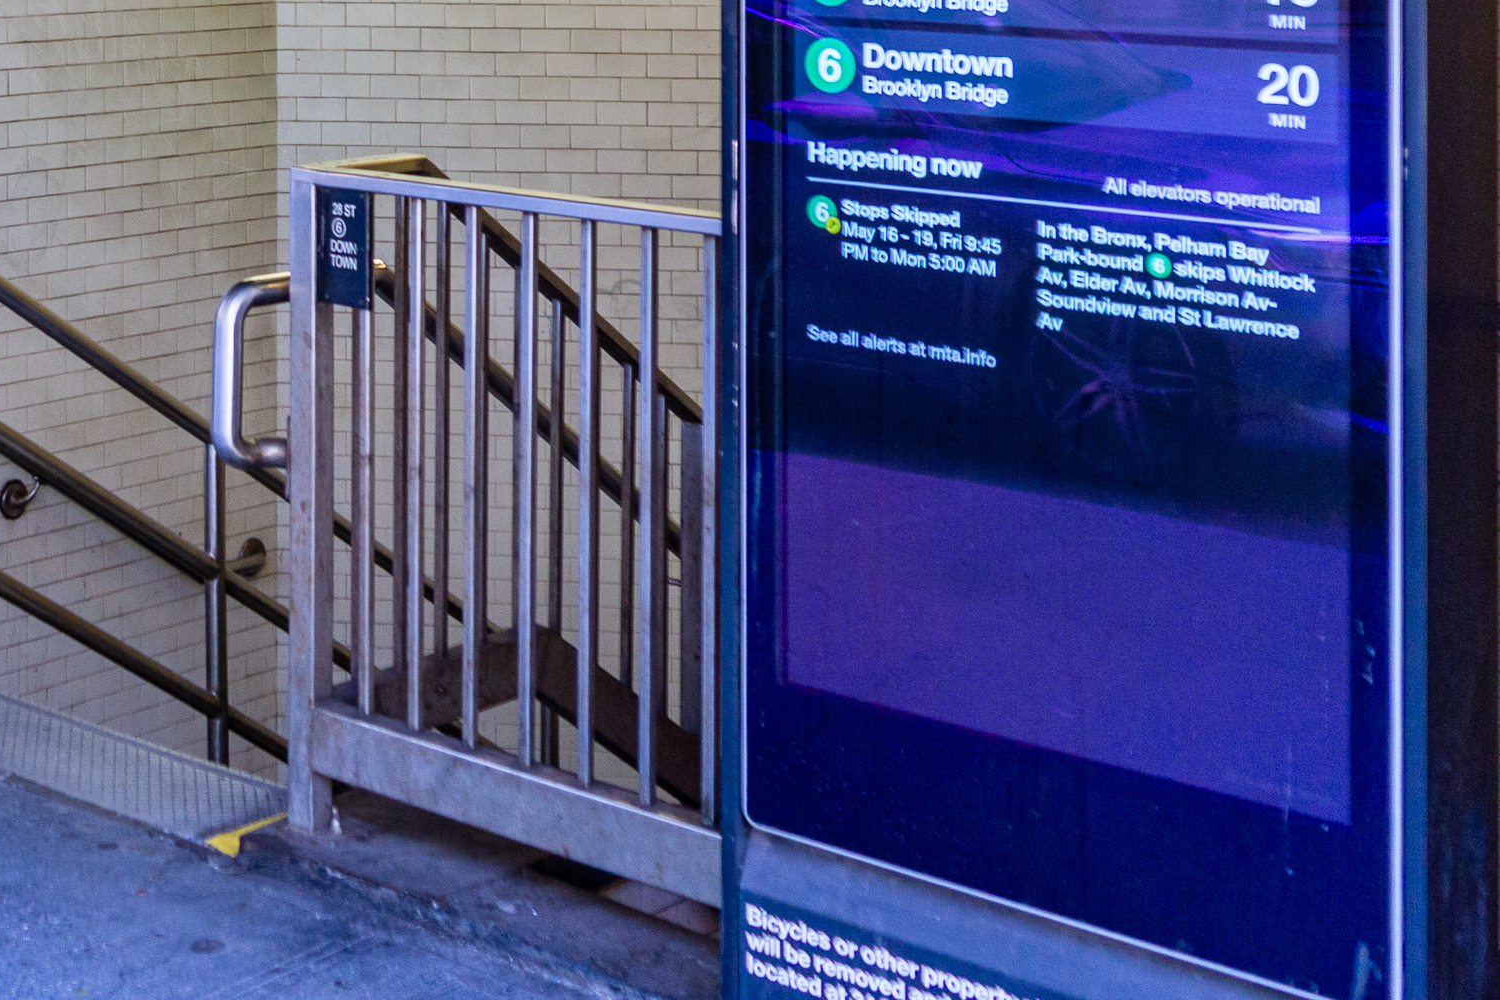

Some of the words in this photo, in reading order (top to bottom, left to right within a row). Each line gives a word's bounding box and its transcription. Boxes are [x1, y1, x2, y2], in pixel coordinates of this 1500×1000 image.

[1268, 14, 1306, 30] MIN
[817, 47, 841, 83] 6
[863, 42, 1014, 78] Downtown
[862, 75, 942, 103] Brooklyn
[945, 80, 1009, 108] Bridge
[1257, 62, 1320, 107] 20
[1268, 112, 1306, 129] MIN
[807, 141, 927, 178] Happening
[930, 157, 983, 179] now
[332, 202, 343, 216] 28
[344, 204, 357, 218] ST
[814, 202, 830, 223] 6
[1103, 176, 1127, 195] All
[1129, 179, 1212, 203] elevators
[1213, 191, 1320, 214] operational
[840, 198, 889, 221] Stops
[891, 204, 961, 229] Skipped
[841, 220, 876, 243] May
[878, 225, 899, 243] 16
[912, 229, 937, 250] 19,
[939, 231, 962, 251] Fri
[964, 235, 1002, 255] 9:45
[1037, 219, 1056, 239] In
[1058, 223, 1089, 243] the
[1090, 225, 1152, 252] Bronx,
[1154, 232, 1226, 258] Pelham
[1228, 240, 1270, 266] Bay
[330, 254, 357, 271] TOWN
[841, 241, 868, 261] PM
[871, 246, 888, 264] to
[890, 248, 926, 269] Mon
[928, 253, 965, 274] 5:00
[966, 258, 997, 277] AM
[1037, 242, 1143, 273] Park-bound
[1152, 258, 1165, 274] 6
[1172, 261, 1226, 284] skips
[1227, 264, 1316, 293] Whitlock
[1036, 266, 1067, 289] Av,
[1069, 269, 1119, 293] Elder
[1119, 276, 1151, 300] Av,
[1153, 280, 1239, 307] Morrison
[1241, 291, 1278, 312] Av-
[1036, 288, 1136, 319] Soundview
[1138, 303, 1176, 324] and
[1177, 306, 1201, 328] St
[1203, 310, 1299, 339] Lawrence
[1036, 311, 1063, 332] Av
[806, 323, 838, 344] See
[839, 329, 859, 348] all
[860, 332, 906, 355] alerts
[907, 341, 926, 358] at
[927, 344, 998, 368] mta.info
[745, 902, 832, 951] Bicycles
[833, 935, 858, 960] or
[859, 942, 919, 980] other
[745, 930, 781, 959] will
[783, 940, 811, 969] be
[813, 953, 906, 1000] removed
[745, 950, 822, 998] located
